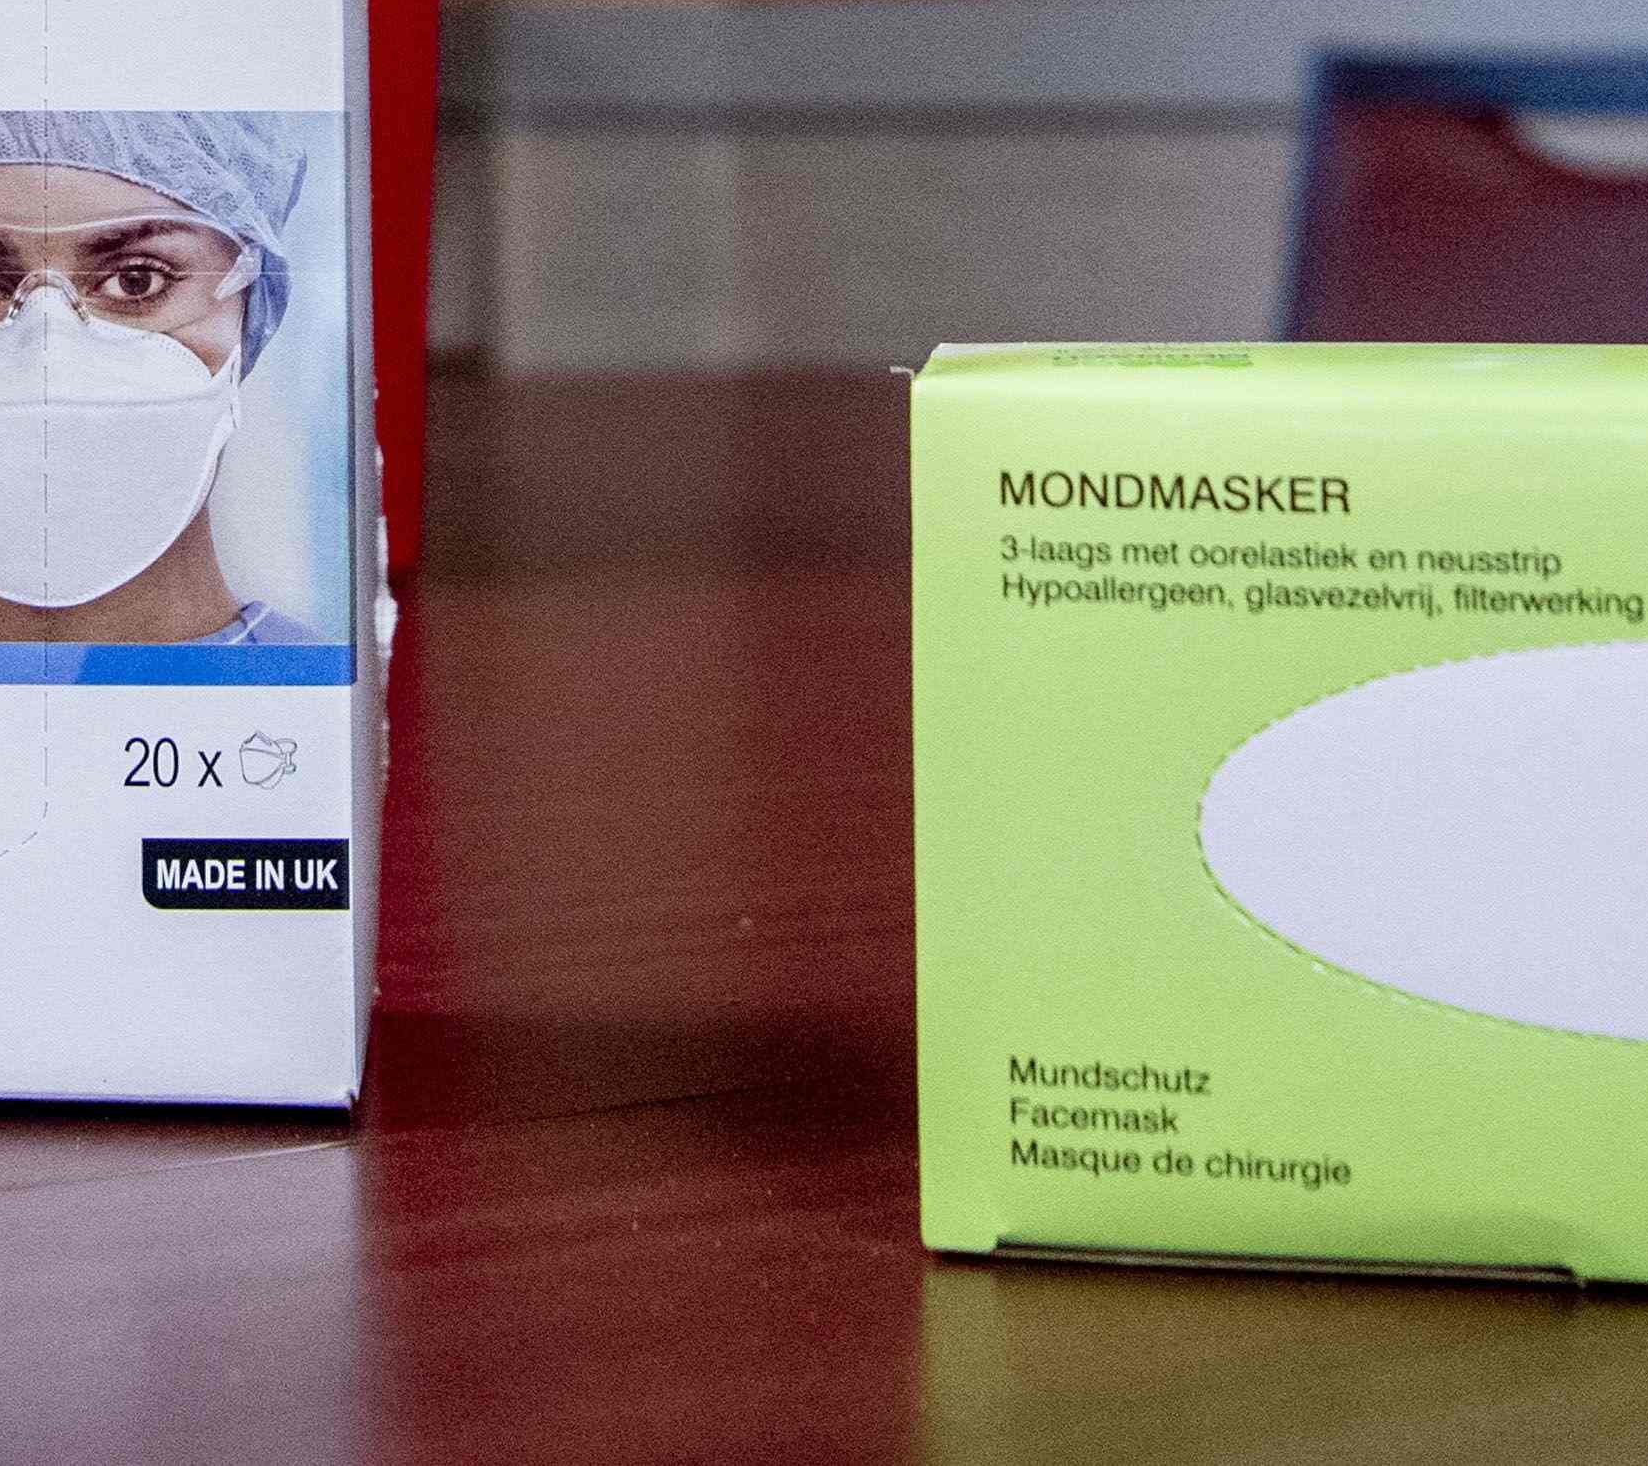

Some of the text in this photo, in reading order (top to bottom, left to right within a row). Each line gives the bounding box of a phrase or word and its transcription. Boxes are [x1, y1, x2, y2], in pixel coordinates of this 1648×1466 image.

[1000, 471, 1351, 514] MONDMASKER
[1001, 535, 1562, 580] 3-laags met oorelastiek en neusstrip
[1002, 573, 1234, 610] Hypoallergeen,
[1245, 581, 1443, 618] glasvezelvrij,
[1453, 585, 1645, 623] filterwerking
[123, 737, 223, 788] 20 x
[156, 858, 339, 891] MADE IN UK
[1009, 1055, 1210, 1094] Mundschutz
[1010, 1097, 1178, 1133] Facemask
[1011, 1139, 1352, 1190] Masque de chirurgie
